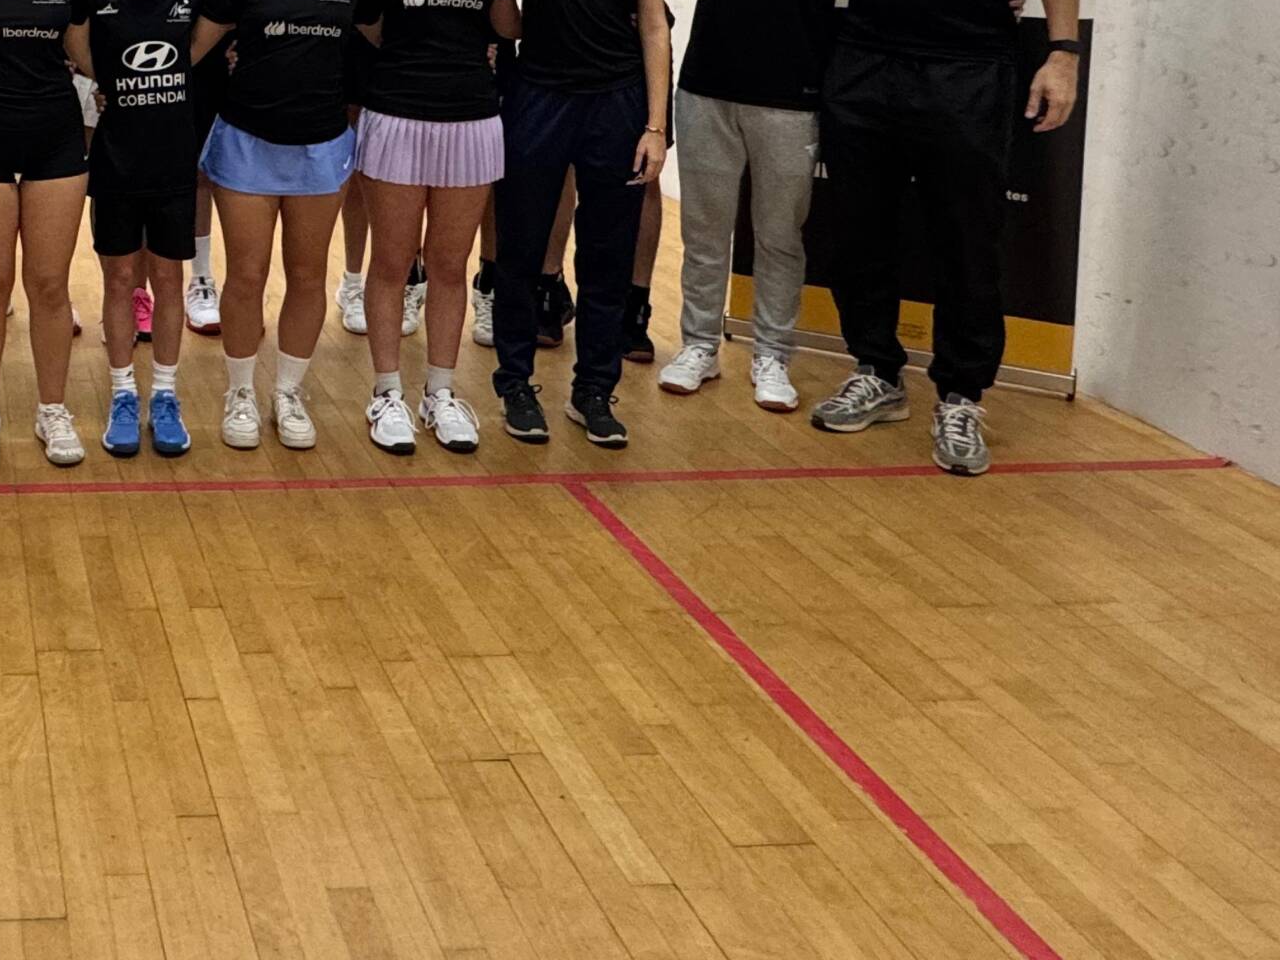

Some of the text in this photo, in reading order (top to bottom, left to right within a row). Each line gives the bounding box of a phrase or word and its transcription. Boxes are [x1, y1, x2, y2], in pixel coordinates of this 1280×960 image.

[2, 26, 60, 40] Iberdrola
[288, 23, 342, 38] Iberdrola
[116, 73, 185, 91] HYUNDAI
[118, 90, 186, 107] COBENDAI
